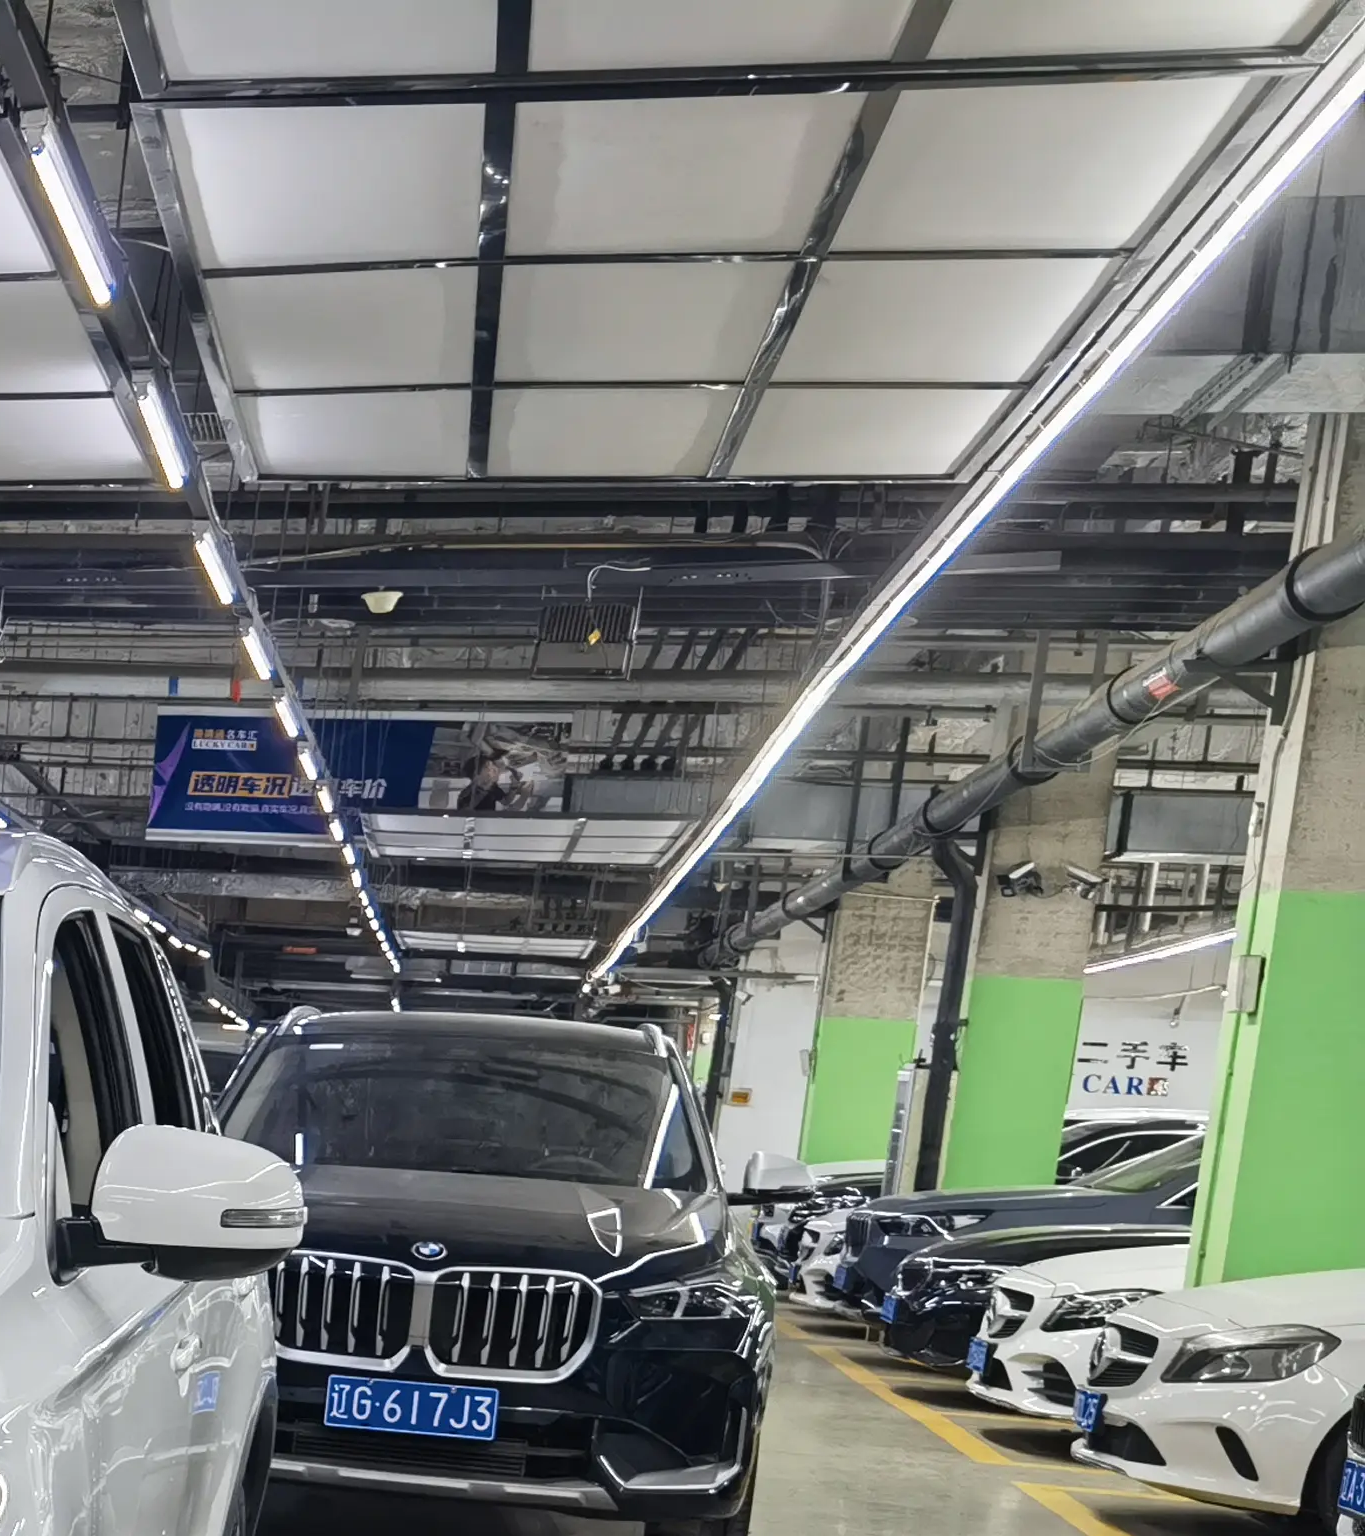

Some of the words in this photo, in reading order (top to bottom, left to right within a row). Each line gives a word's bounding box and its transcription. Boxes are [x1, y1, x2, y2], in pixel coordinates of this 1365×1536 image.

[193, 774, 287, 796] 透明车况
[1077, 1041, 1189, 1071] 二手车
[1082, 1074, 1144, 1096] CAR
